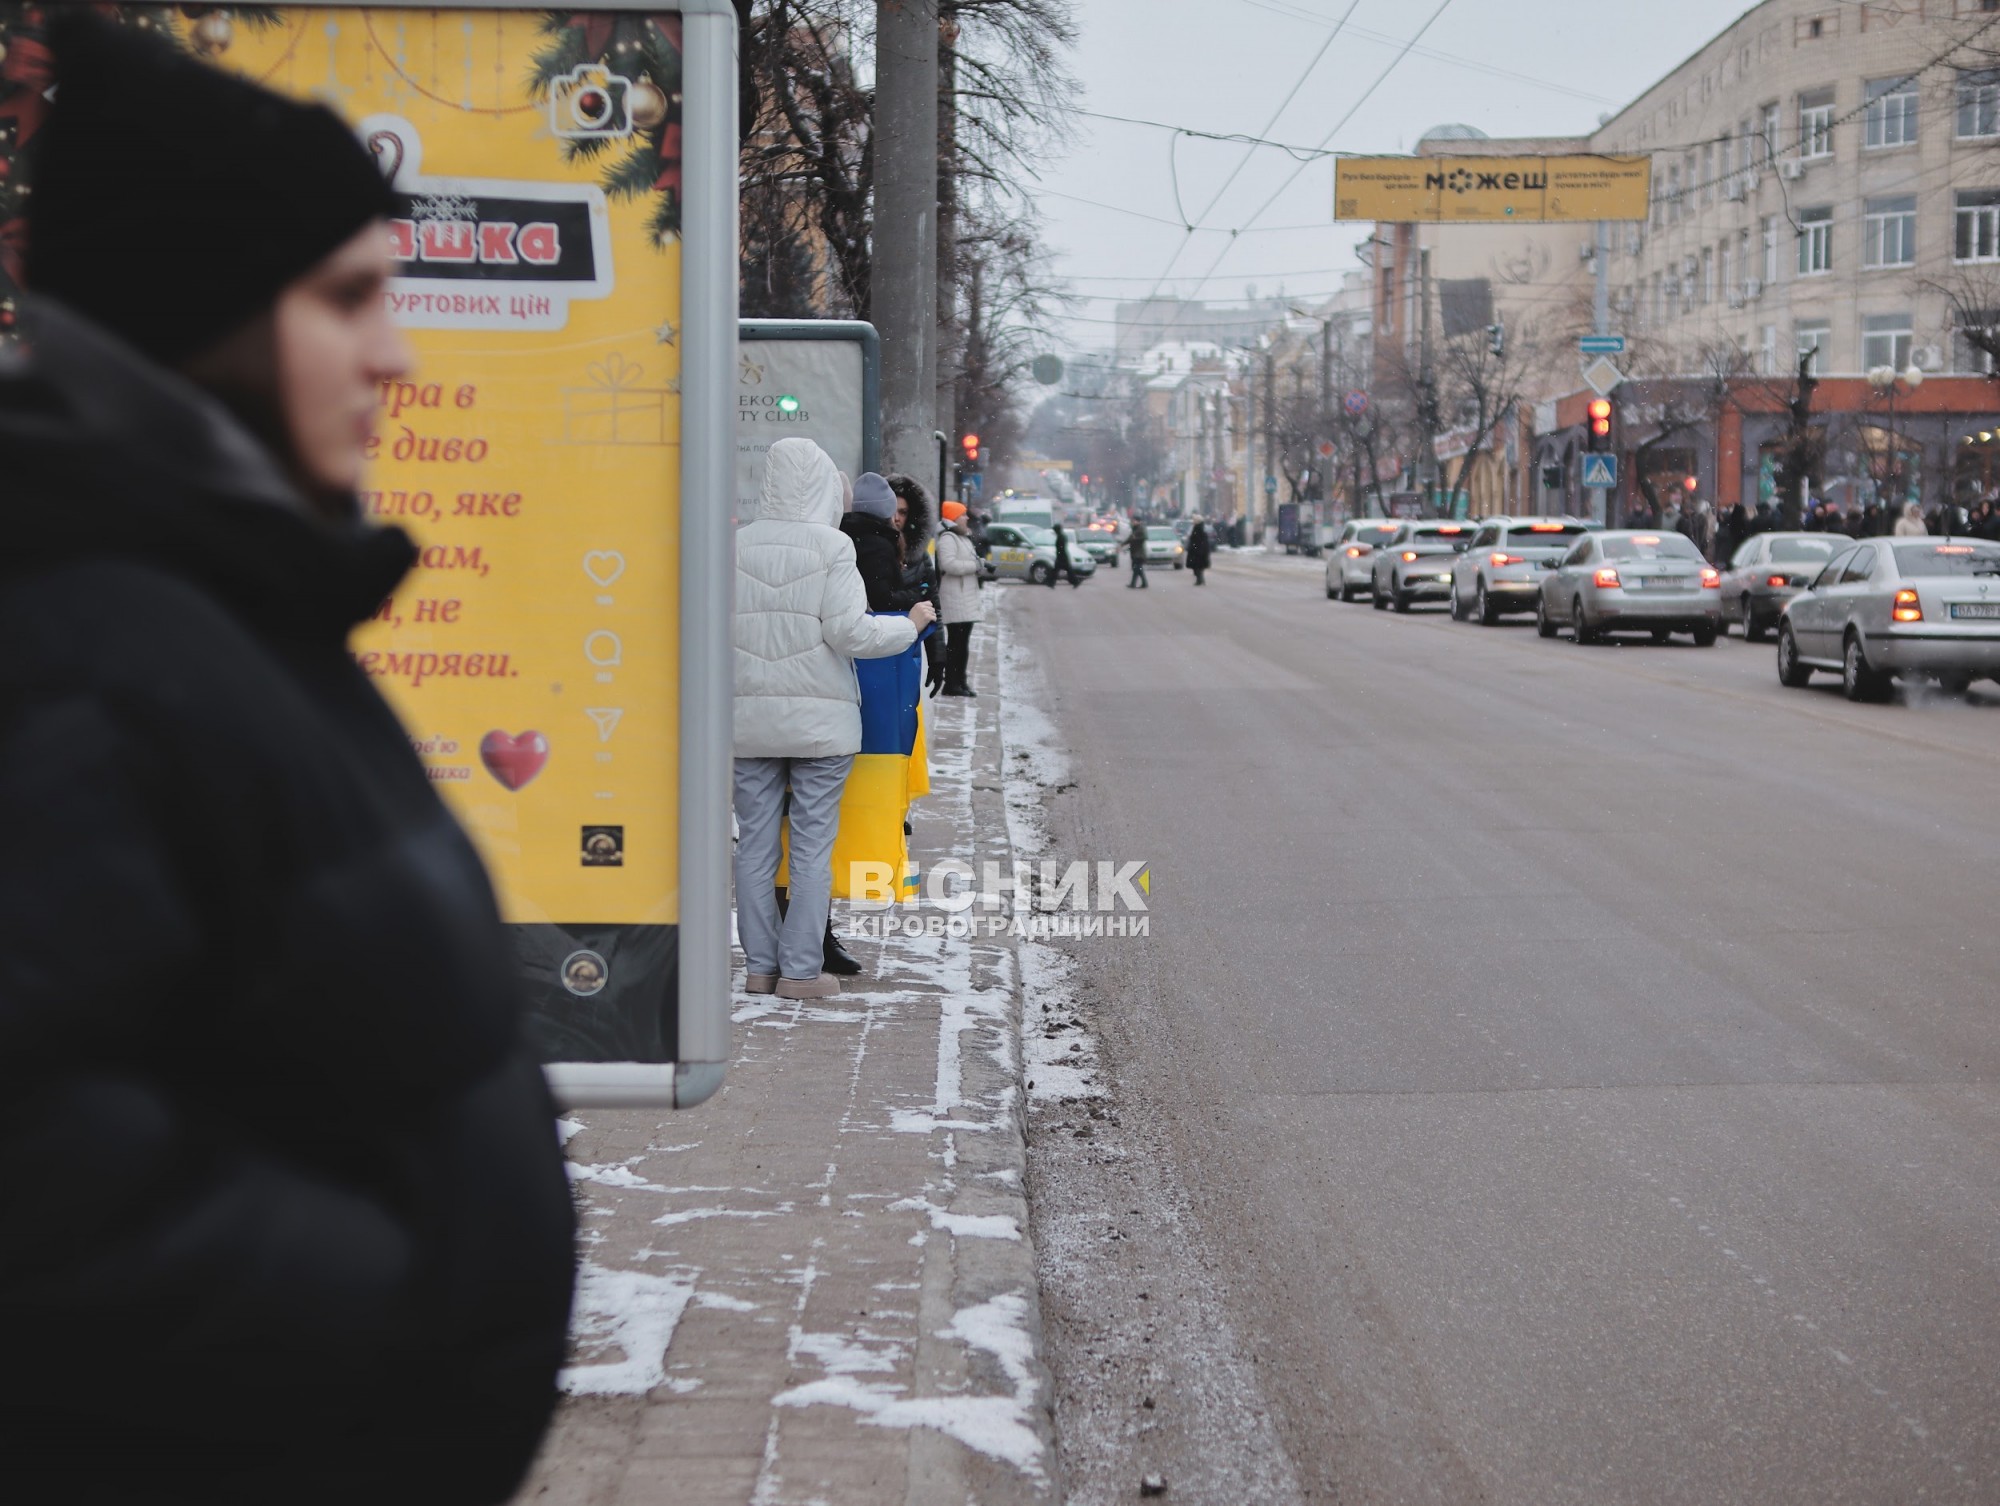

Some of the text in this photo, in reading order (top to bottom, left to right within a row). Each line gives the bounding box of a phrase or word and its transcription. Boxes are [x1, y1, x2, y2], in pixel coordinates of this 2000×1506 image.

[765, 410, 810, 421] CLUB
[392, 425, 488, 462] диво
[452, 492, 522, 516] яке
[414, 598, 461, 623] не
[352, 651, 519, 687] емряви.
